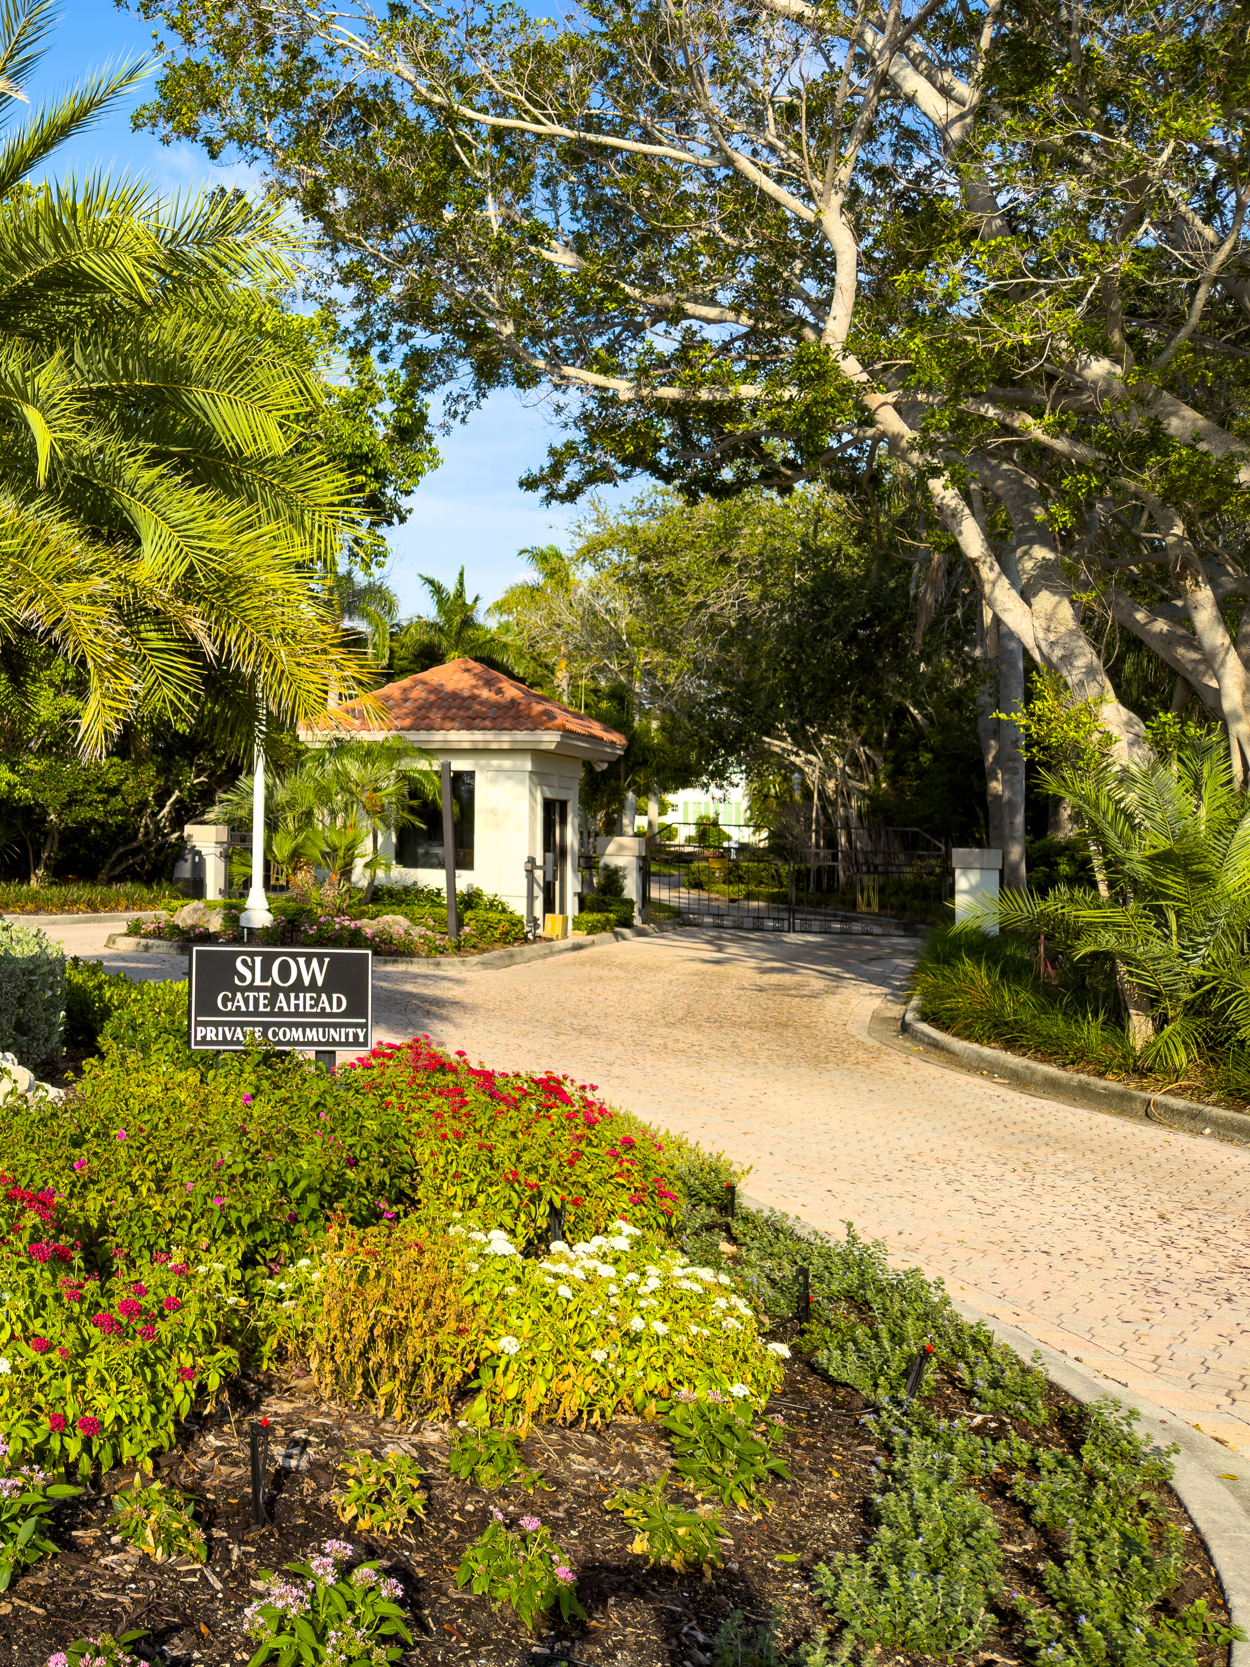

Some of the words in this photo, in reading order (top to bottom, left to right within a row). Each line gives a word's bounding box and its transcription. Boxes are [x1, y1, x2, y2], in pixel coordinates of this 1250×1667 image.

[234, 956, 331, 987] SLOW
[217, 992, 271, 1012] GATE
[274, 993, 348, 1013] AHEAD
[196, 1026, 263, 1042] PRIVATE
[268, 1027, 367, 1042] COMMUNITY
